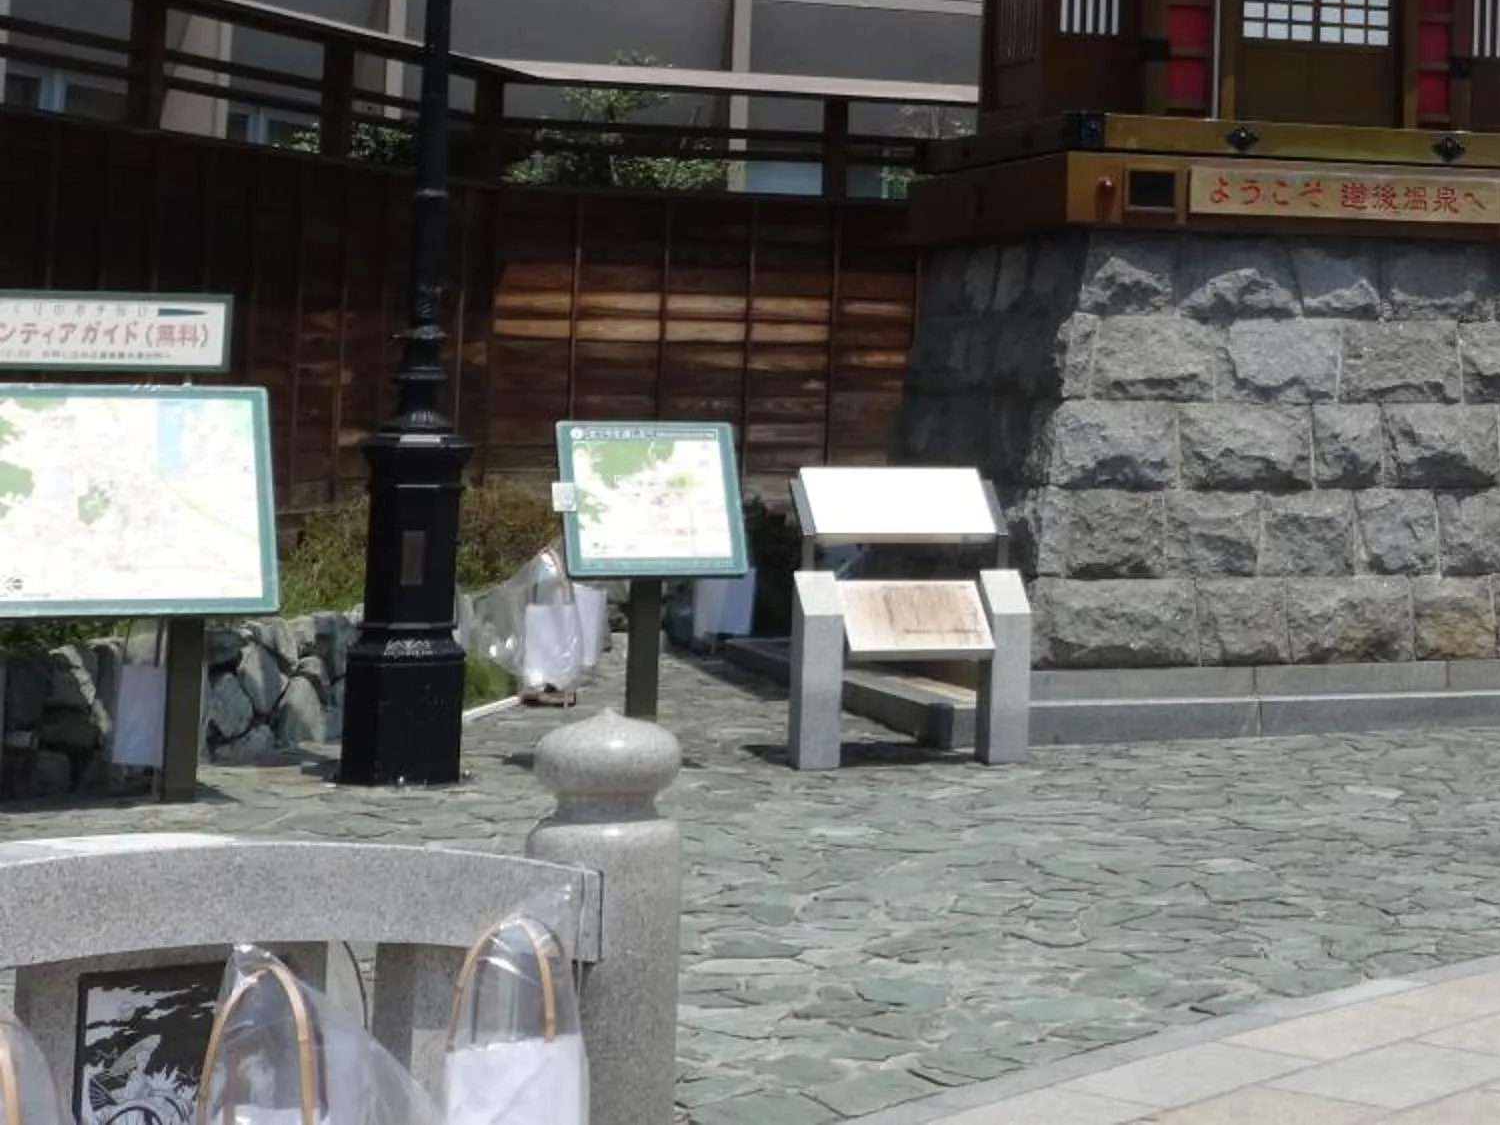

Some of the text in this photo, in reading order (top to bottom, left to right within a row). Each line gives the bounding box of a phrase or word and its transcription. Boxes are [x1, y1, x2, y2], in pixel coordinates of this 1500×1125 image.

[1209, 177, 1487, 214] ようこそ 道後温泉へ
